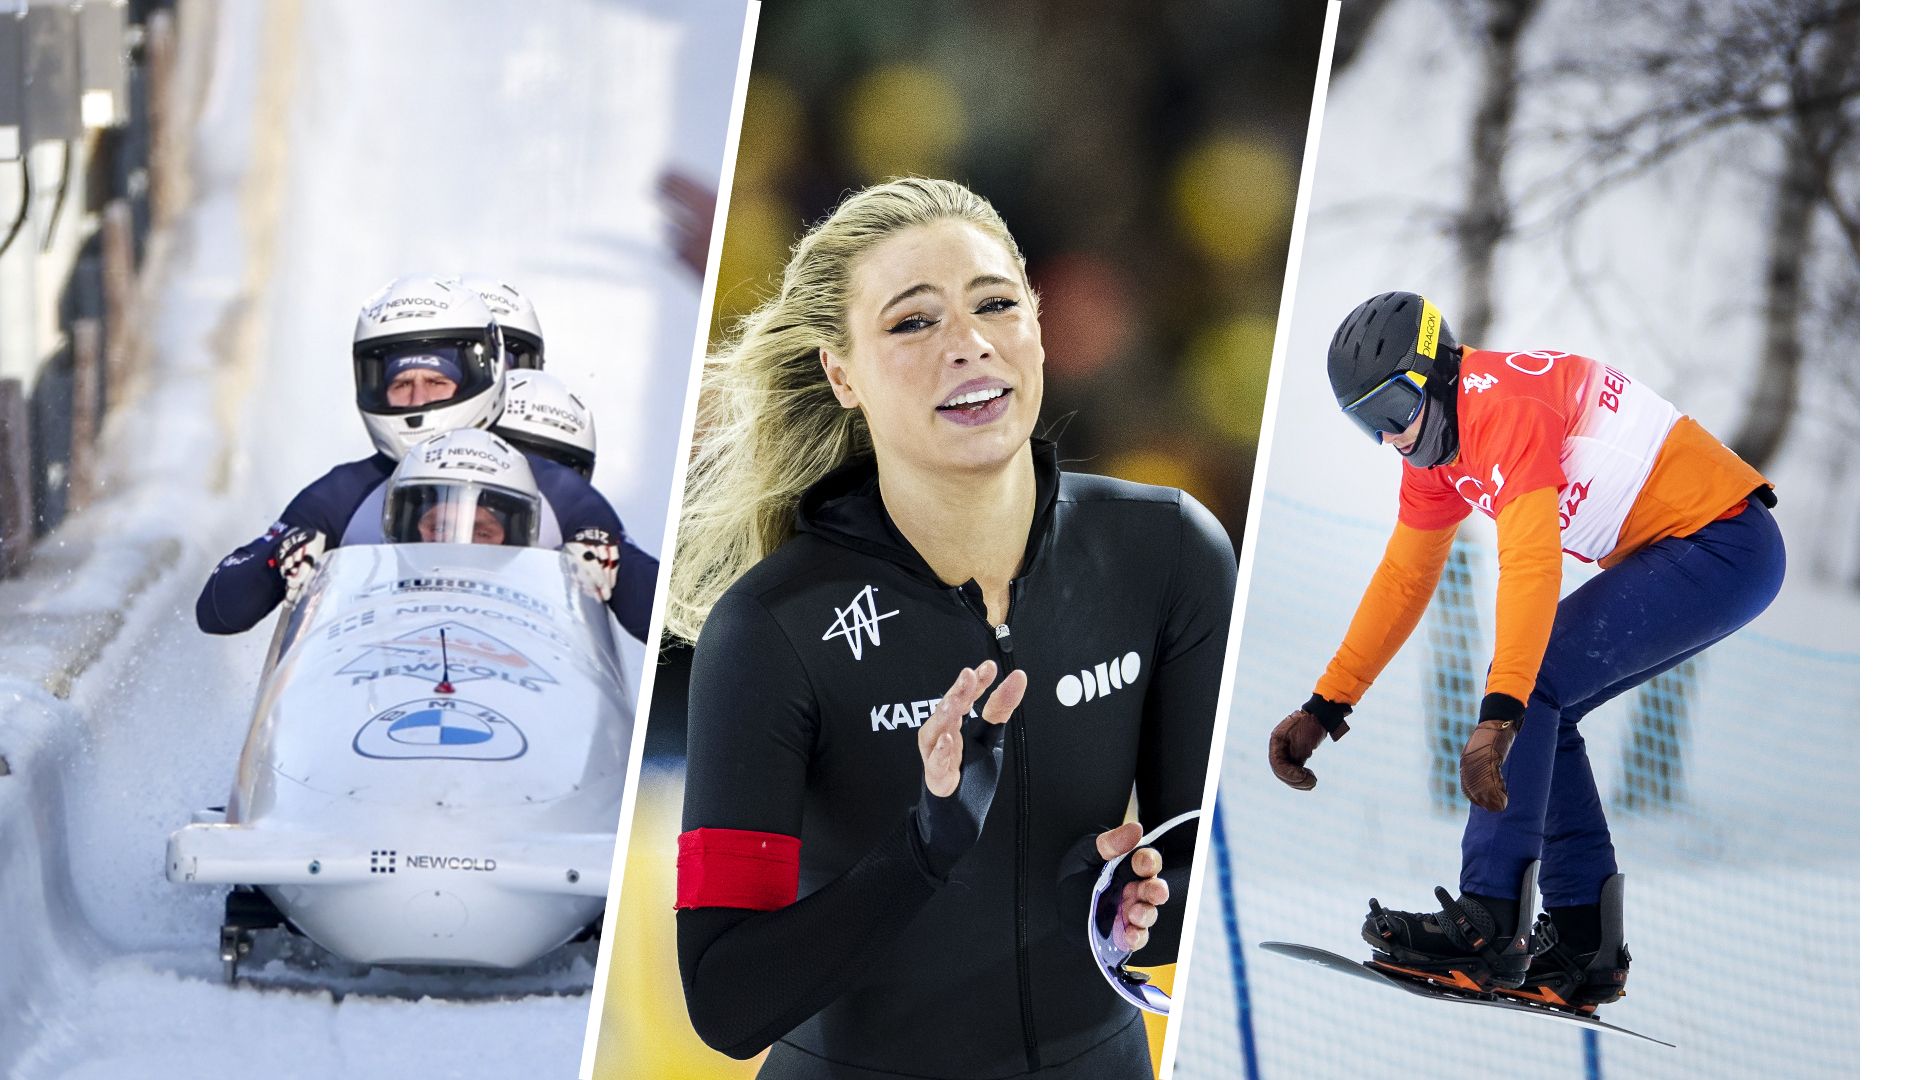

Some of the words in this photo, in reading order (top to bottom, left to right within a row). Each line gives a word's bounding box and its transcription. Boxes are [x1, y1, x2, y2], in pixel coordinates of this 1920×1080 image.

[385, 297, 449, 311] NEWCOLD
[380, 311, 437, 322] LS2
[1423, 312, 1436, 356] DRAGON
[398, 356, 441, 367] FILA
[524, 414, 577, 435] LS2
[531, 403, 585, 430] NEWCOLD
[448, 447, 510, 470] NEWCOLD
[438, 461, 497, 475] LS2
[575, 529, 609, 544] SEIZ
[396, 605, 571, 648] NEWCOLD
[352, 663, 543, 693] NEWCOLD
[406, 856, 498, 872] NEWCOLD
